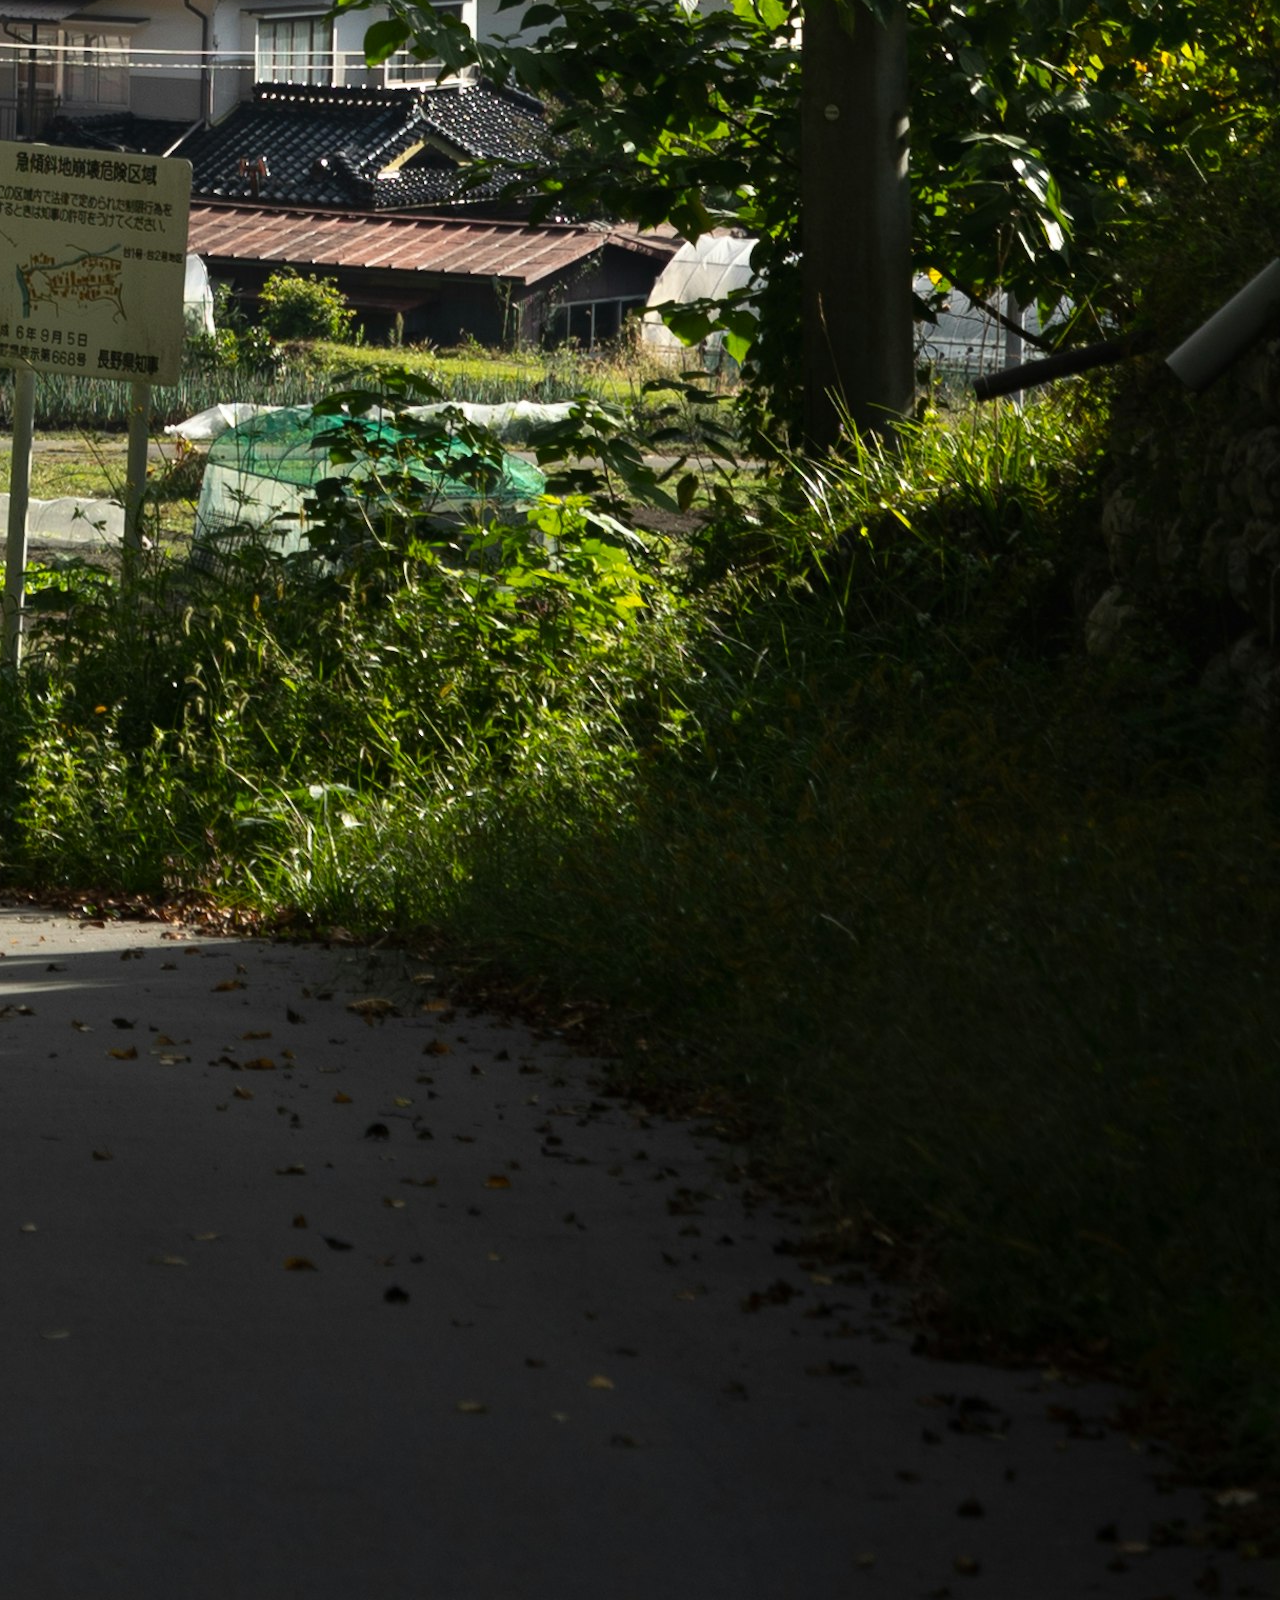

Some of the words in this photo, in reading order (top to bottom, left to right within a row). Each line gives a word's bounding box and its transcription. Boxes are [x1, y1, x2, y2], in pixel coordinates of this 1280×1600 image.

[16, 151, 157, 186] 急傾斜地崩壊危険区域
[97, 349, 160, 375] 長野県知事
